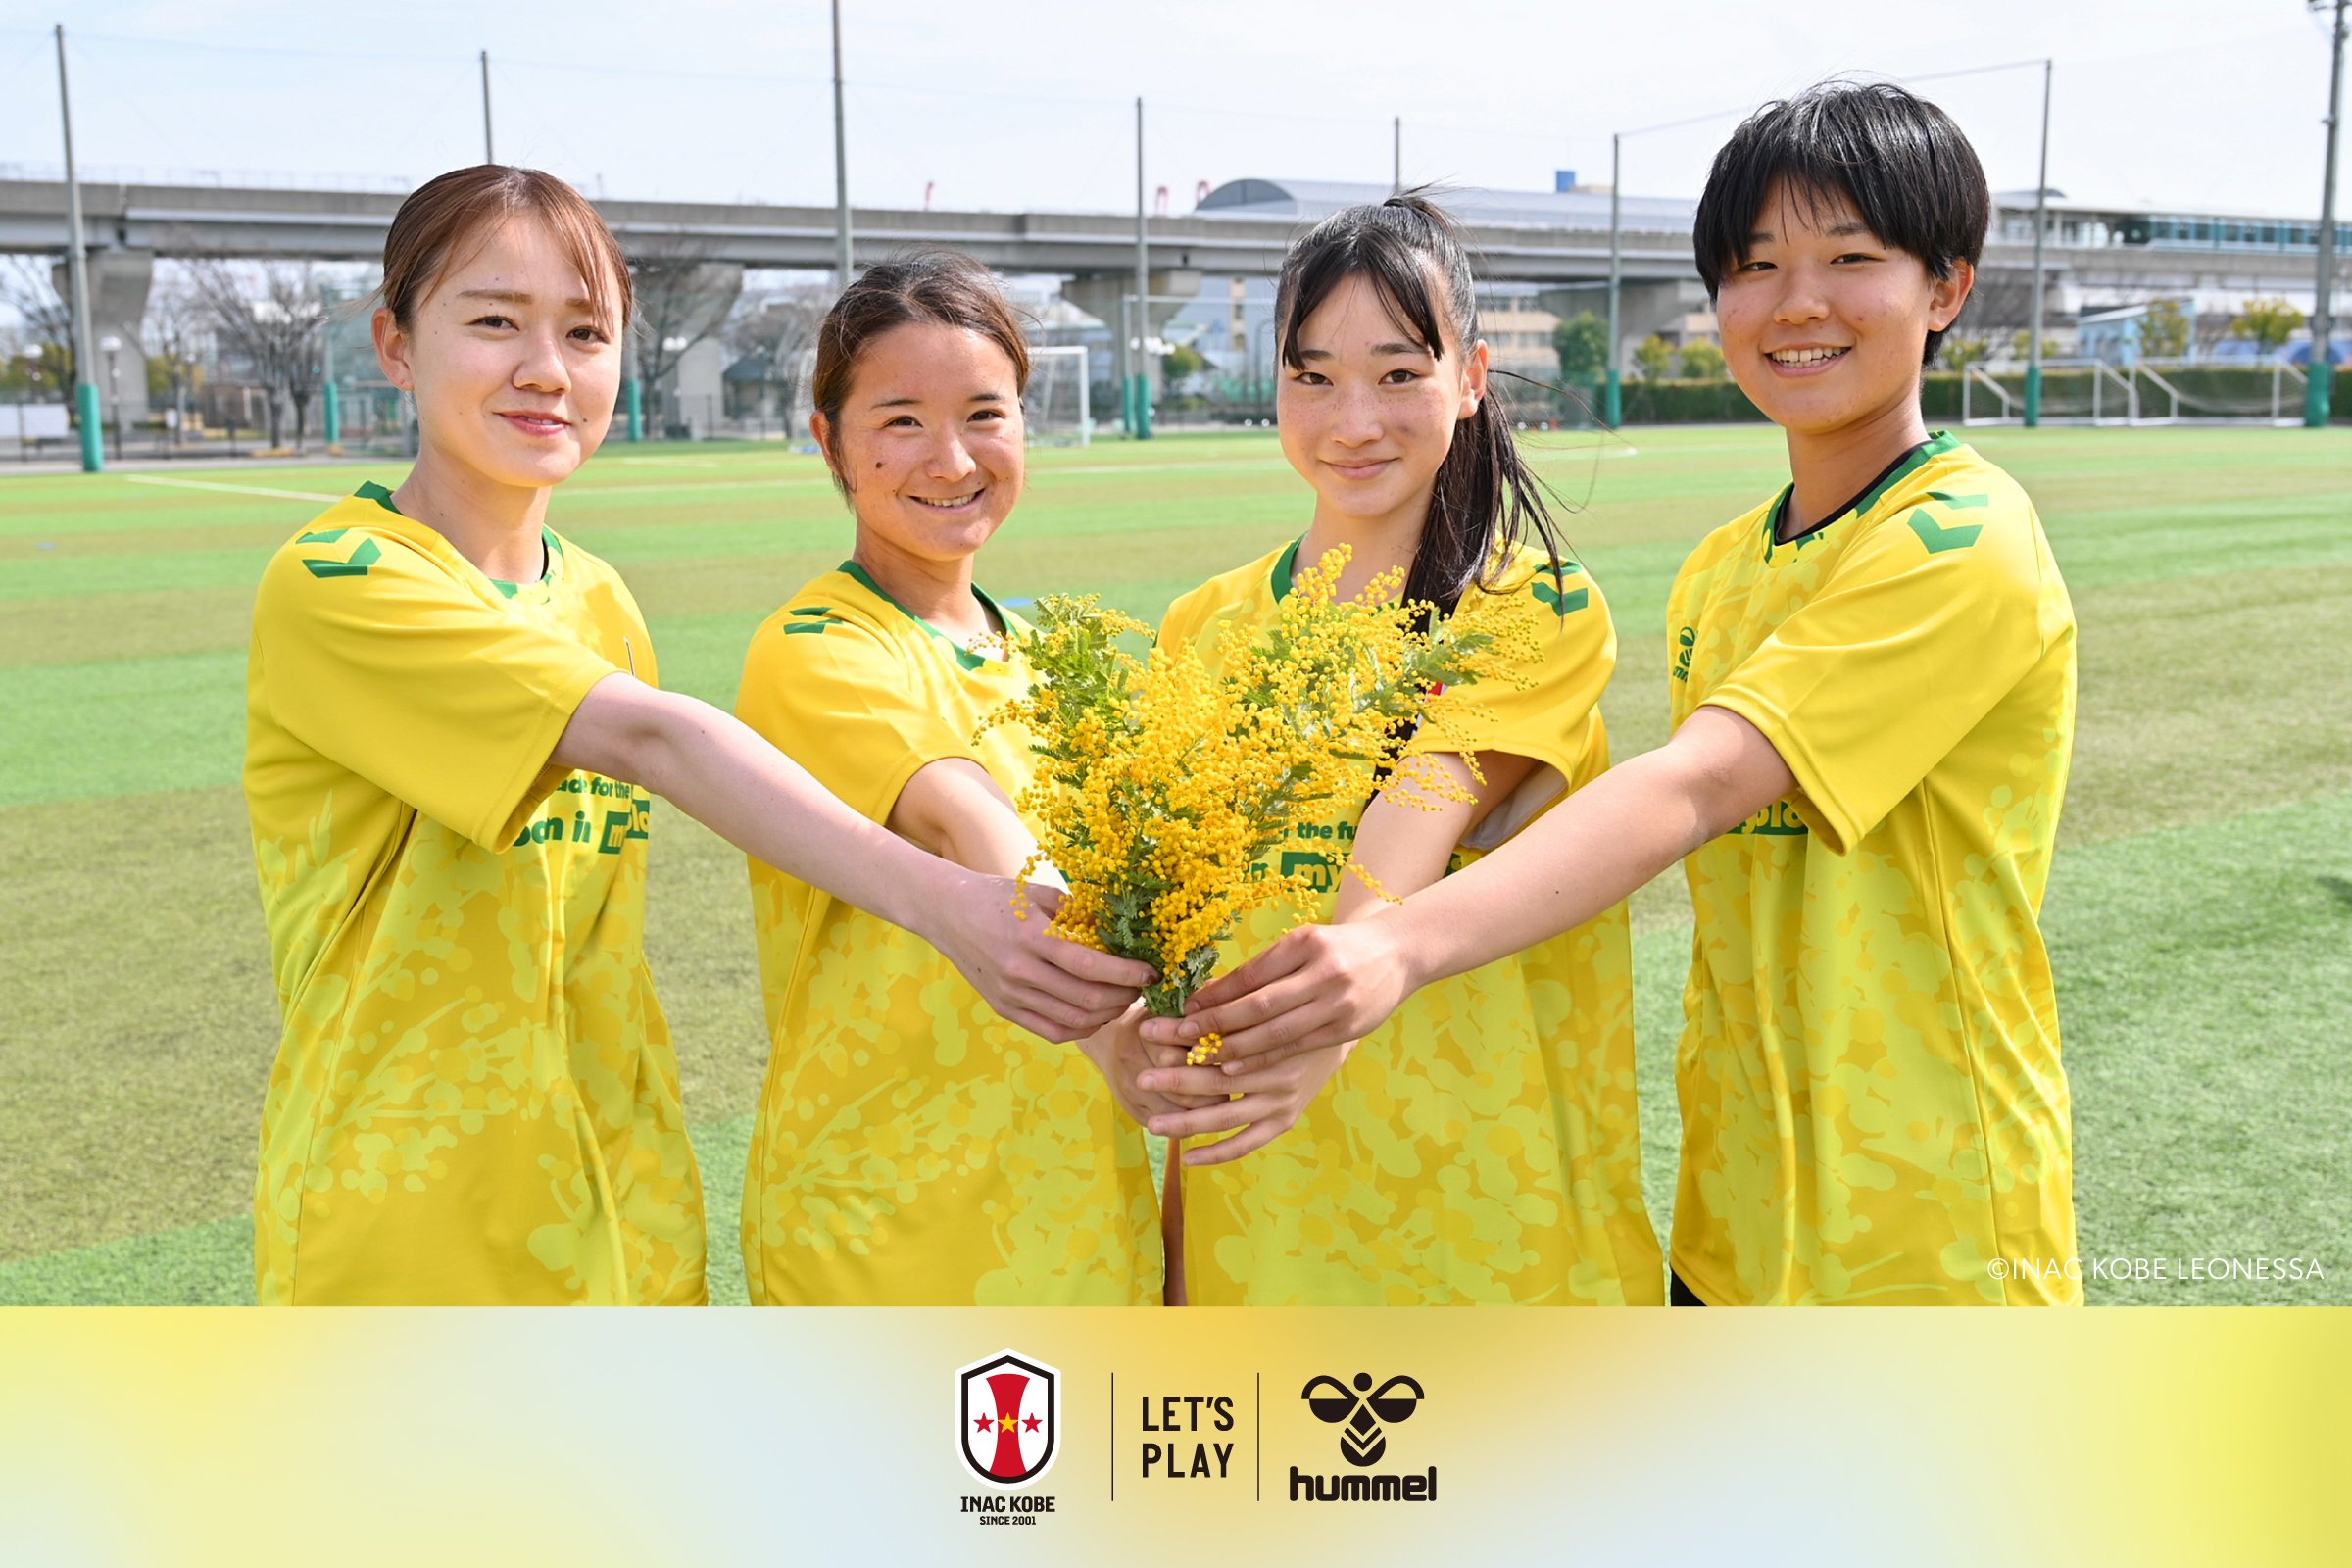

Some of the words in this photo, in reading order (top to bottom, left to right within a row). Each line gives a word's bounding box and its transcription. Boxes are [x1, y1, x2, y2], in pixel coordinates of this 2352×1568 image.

[590, 777, 614, 797] for
[614, 780, 630, 799] the
[572, 810, 592, 843] in
[1297, 821, 1334, 839] the
